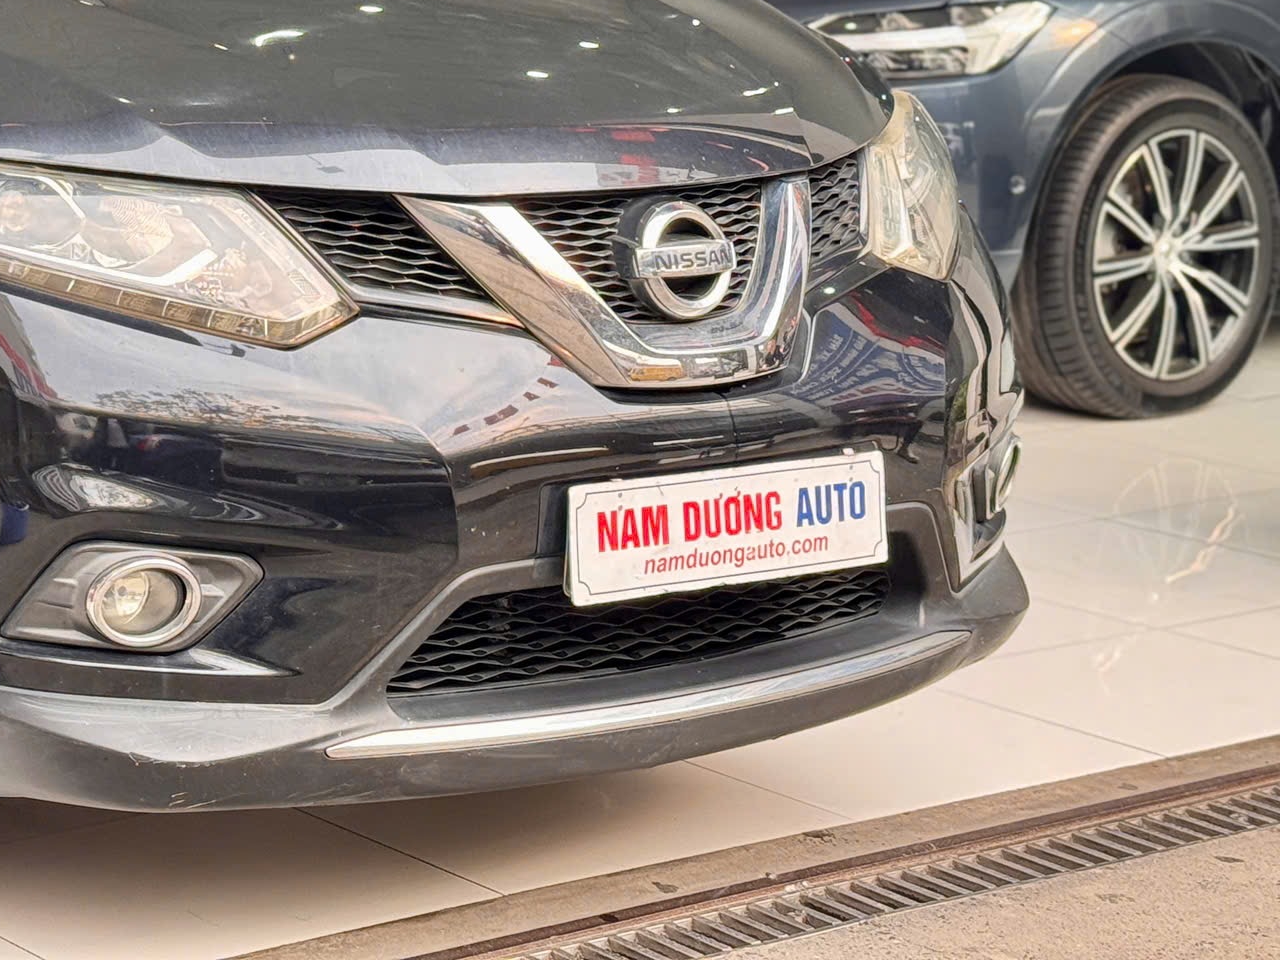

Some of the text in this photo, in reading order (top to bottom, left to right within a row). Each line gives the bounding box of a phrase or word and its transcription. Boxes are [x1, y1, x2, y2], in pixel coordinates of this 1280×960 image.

[654, 248, 730, 271] NISSAN
[597, 480, 867, 553] NAM DƯƠNG AUTO
[643, 535, 829, 576] namduongauto.com
